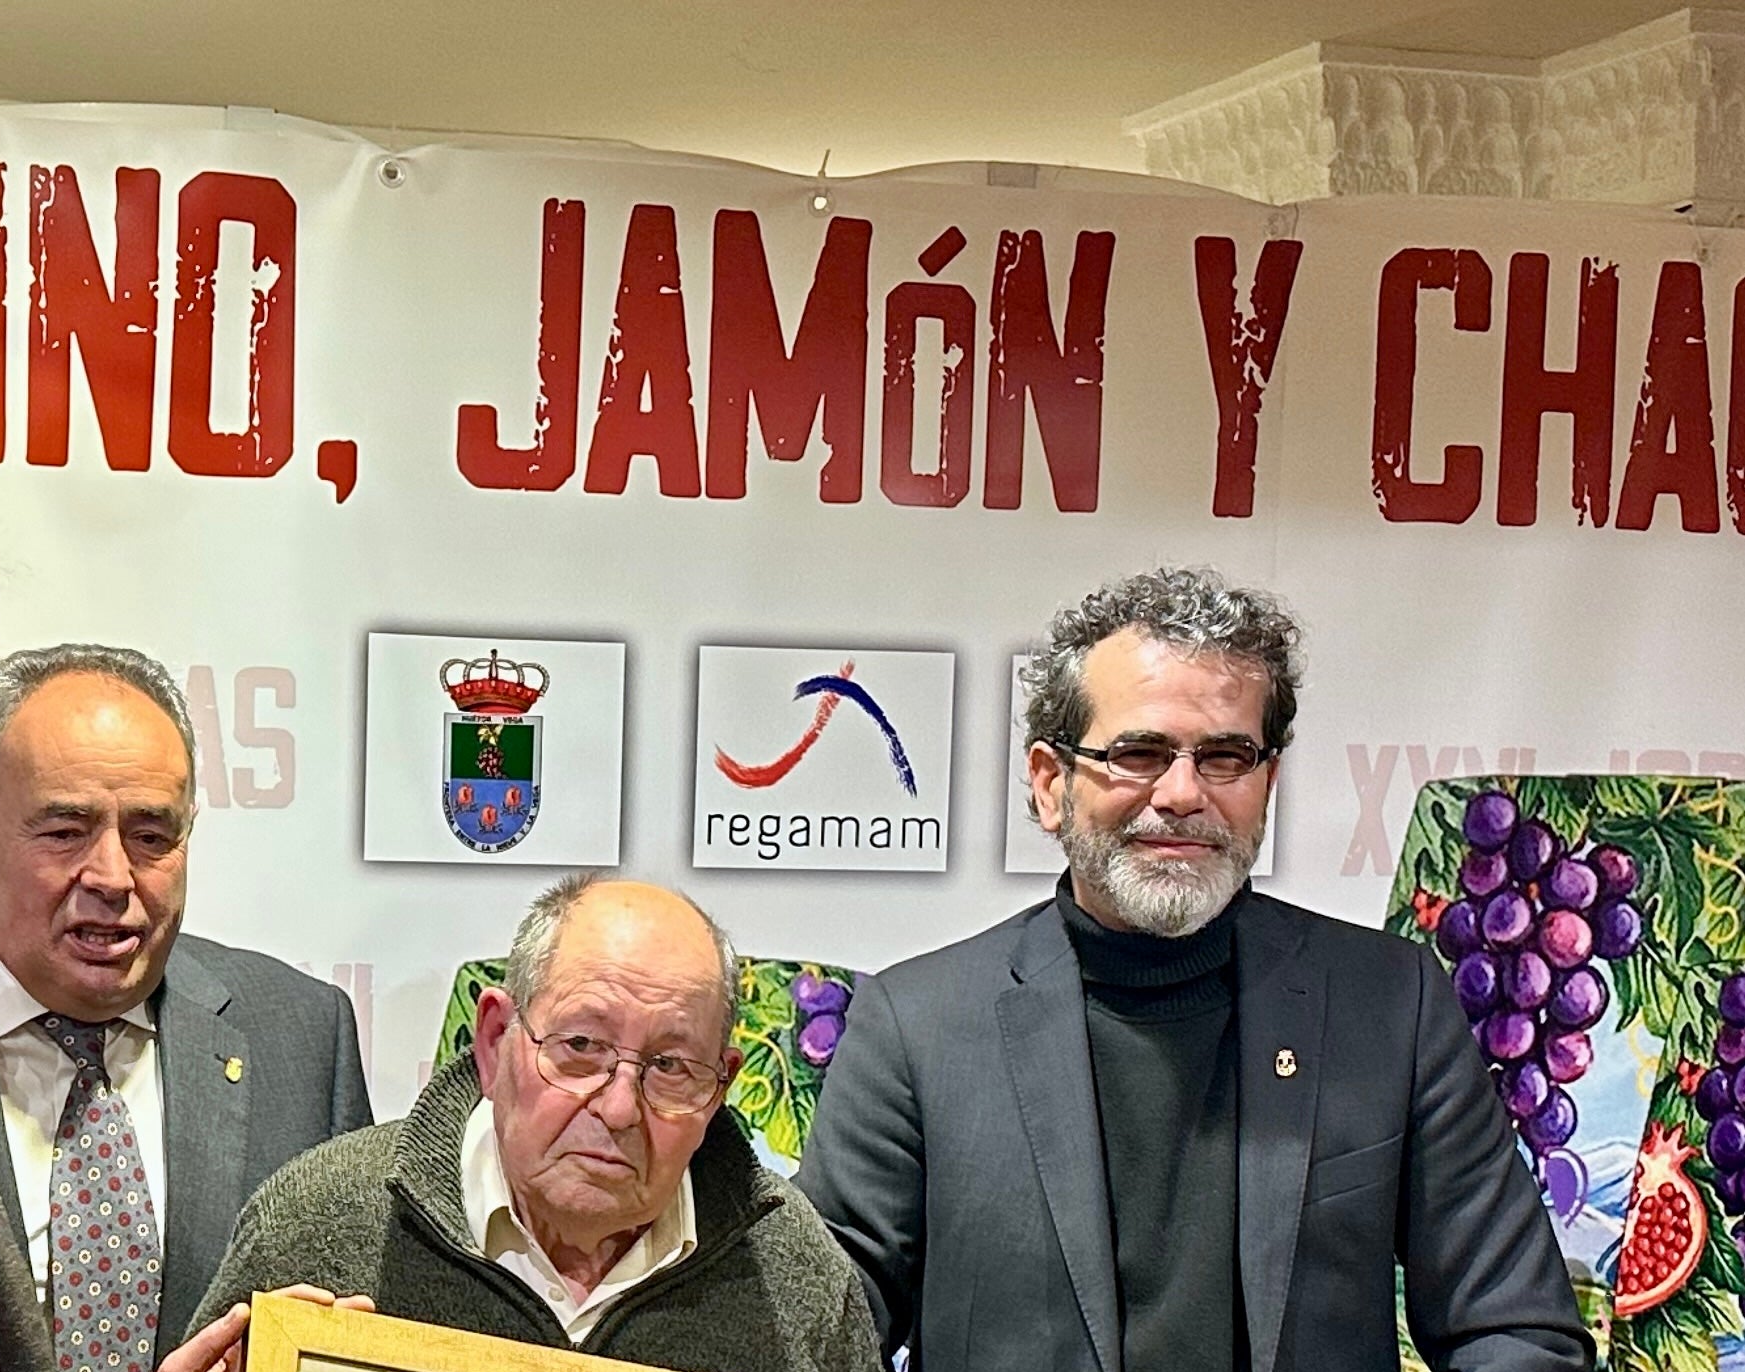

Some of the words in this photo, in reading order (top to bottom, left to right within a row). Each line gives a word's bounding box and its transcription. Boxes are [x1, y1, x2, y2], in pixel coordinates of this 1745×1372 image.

[457, 199, 1114, 512] JAMÓN
[1195, 237, 1302, 517] Y
[1372, 248, 1745, 535] CHA
[706, 811, 941, 861] regamam
